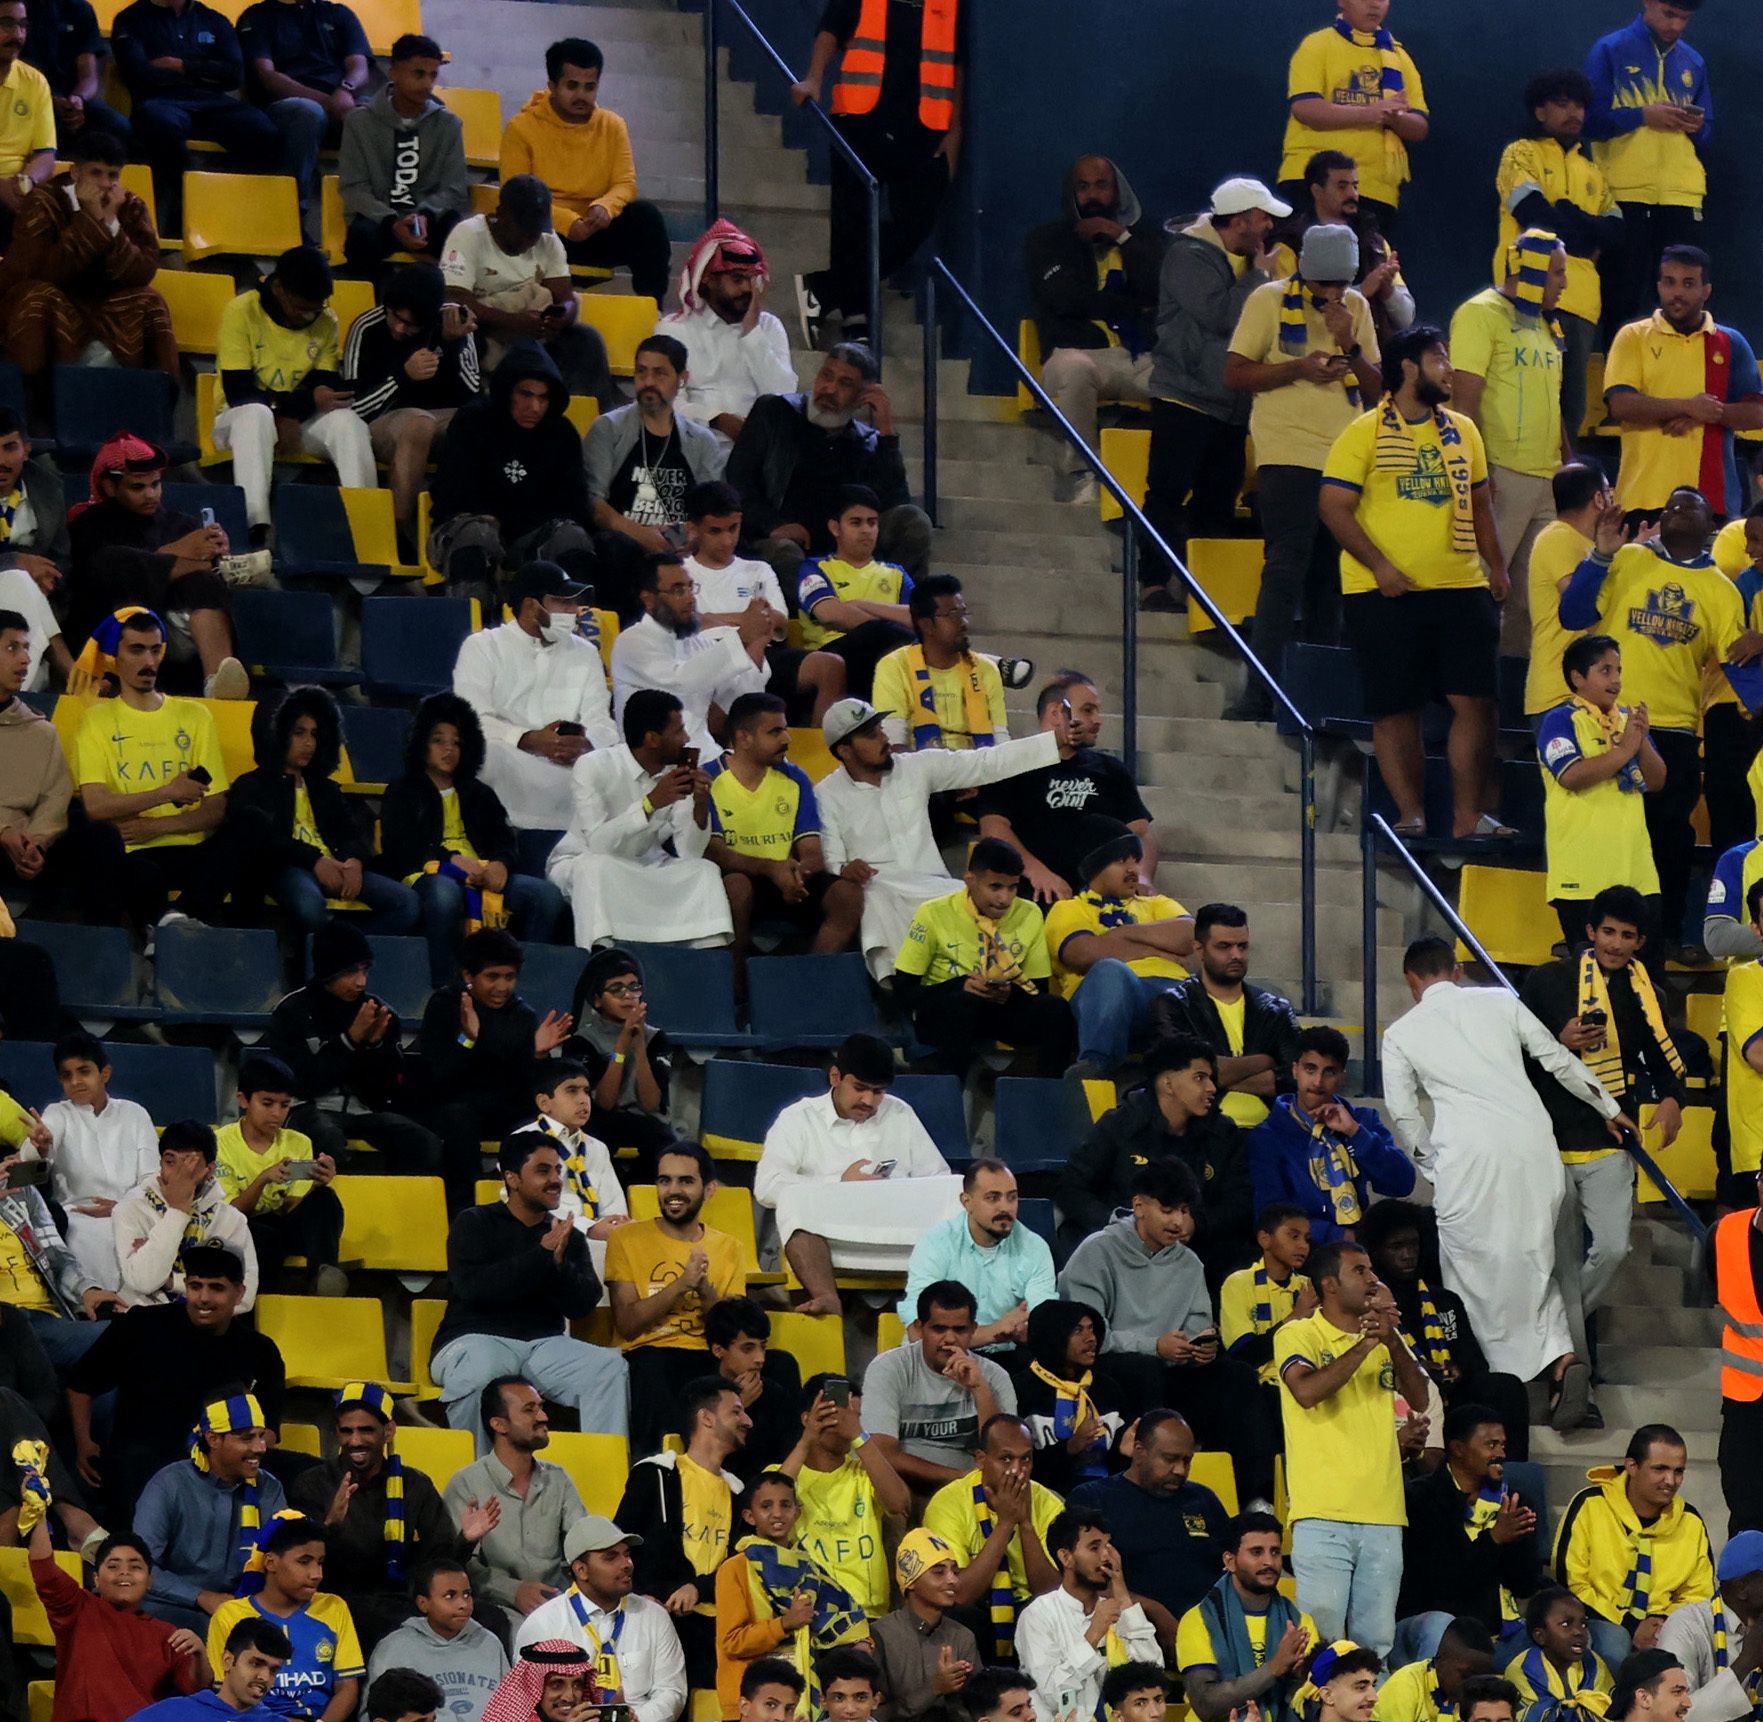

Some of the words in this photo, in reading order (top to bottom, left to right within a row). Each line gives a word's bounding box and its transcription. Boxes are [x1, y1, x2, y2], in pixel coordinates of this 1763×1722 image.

[391, 136, 419, 206] TODAY
[1514, 347, 1554, 369] KAF
[1630, 608, 1667, 629] YELLOW
[1051, 778, 1097, 794] never
[922, 1421, 959, 1438] YOUR
[683, 1523, 726, 1546] KAF
